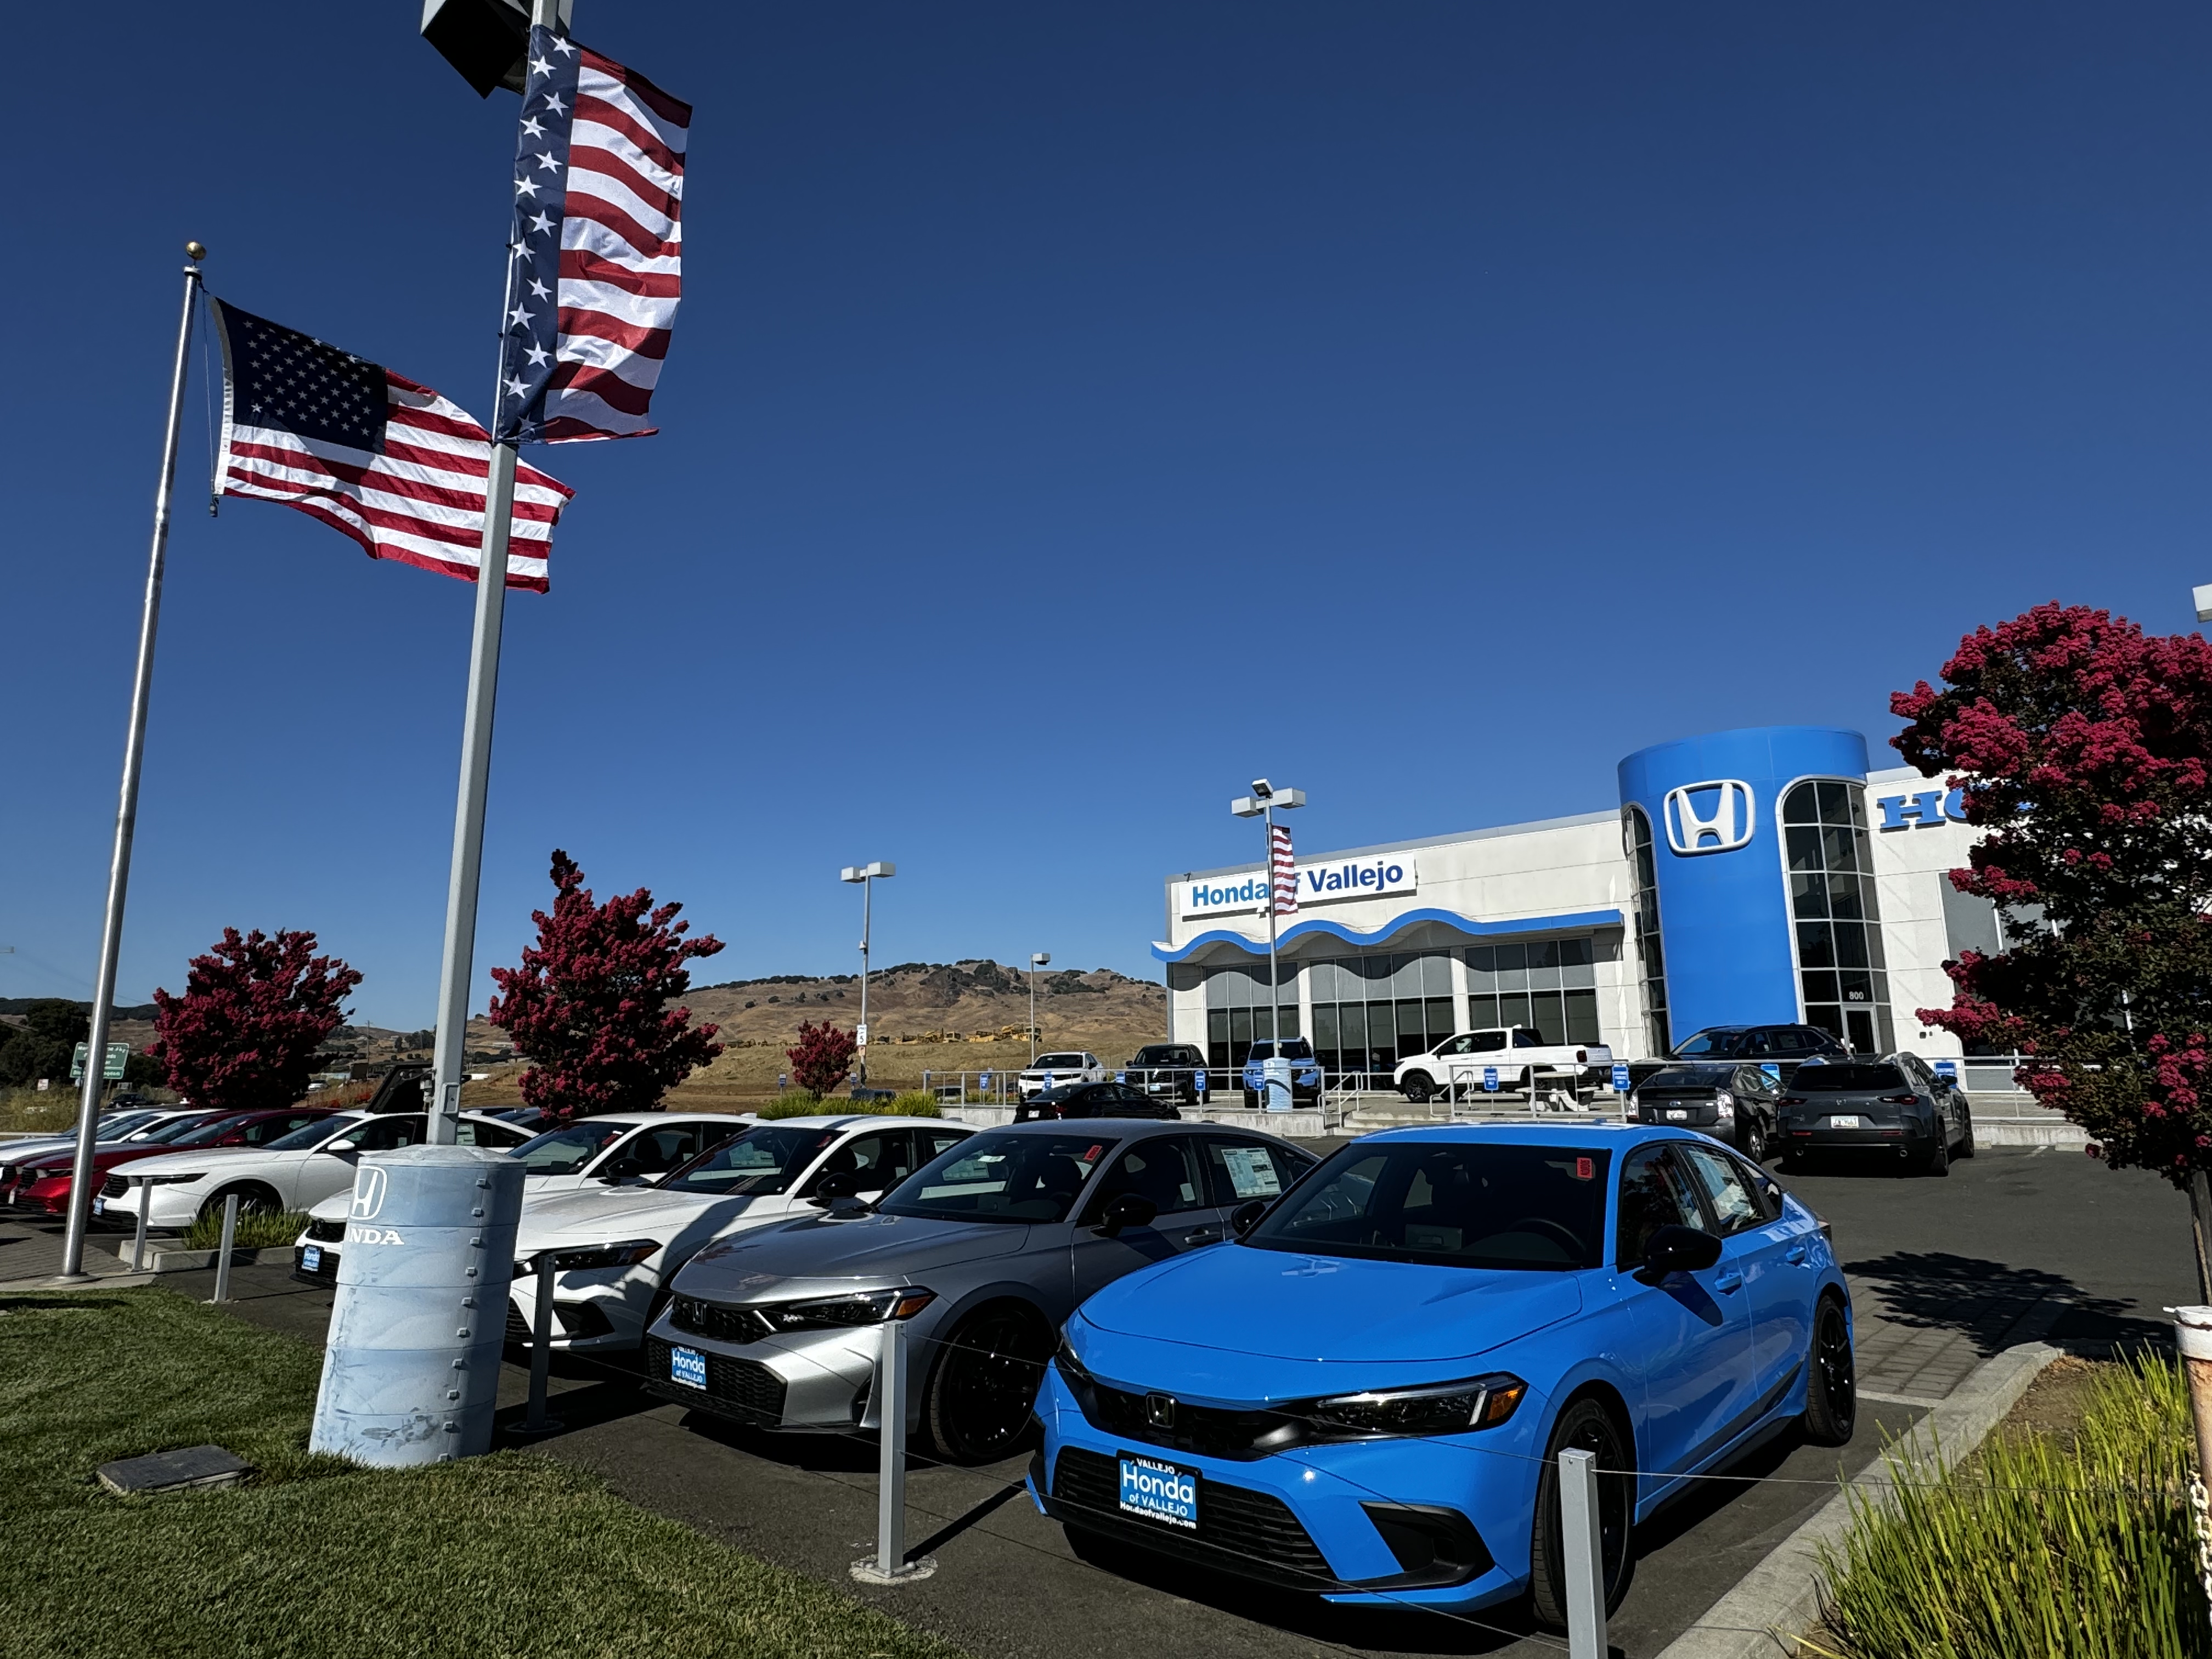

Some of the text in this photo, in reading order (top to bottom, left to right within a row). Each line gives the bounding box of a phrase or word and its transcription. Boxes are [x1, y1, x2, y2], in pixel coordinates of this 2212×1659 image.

[1193, 879, 1269, 907] Honda
[1307, 861, 1403, 893] Vallejo
[1849, 991, 1864, 1000] 800
[673, 1350, 705, 1374] Honda
[1136, 1457, 1175, 1475] VALLEJO
[1122, 1464, 1194, 1504] Honda
[1129, 1493, 1188, 1516] of VALLEJO
